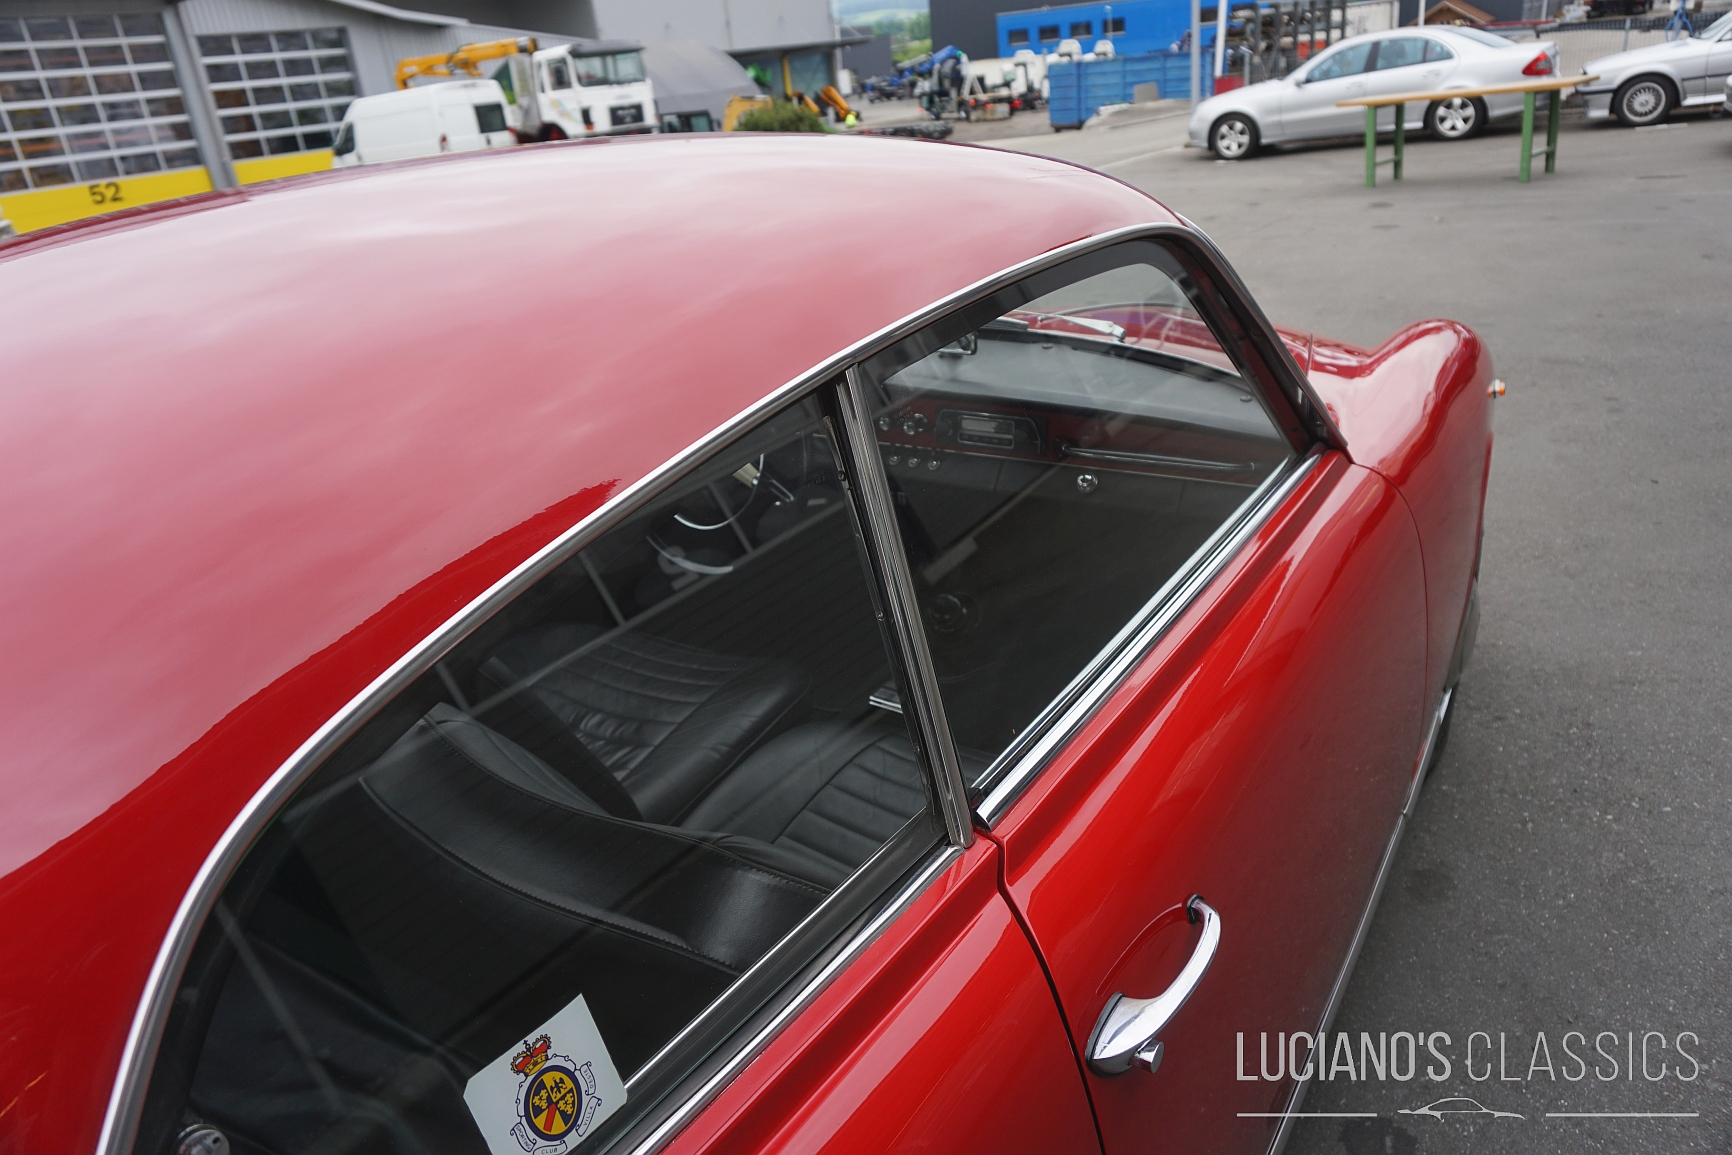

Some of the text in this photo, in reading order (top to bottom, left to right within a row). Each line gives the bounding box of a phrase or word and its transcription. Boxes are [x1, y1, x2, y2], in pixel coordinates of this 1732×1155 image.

[89, 183, 123, 204] 52
[583, 1105, 594, 1126] VILLA
[515, 1124, 532, 1150] SPORTING
[541, 1147, 558, 1155] CLUB
